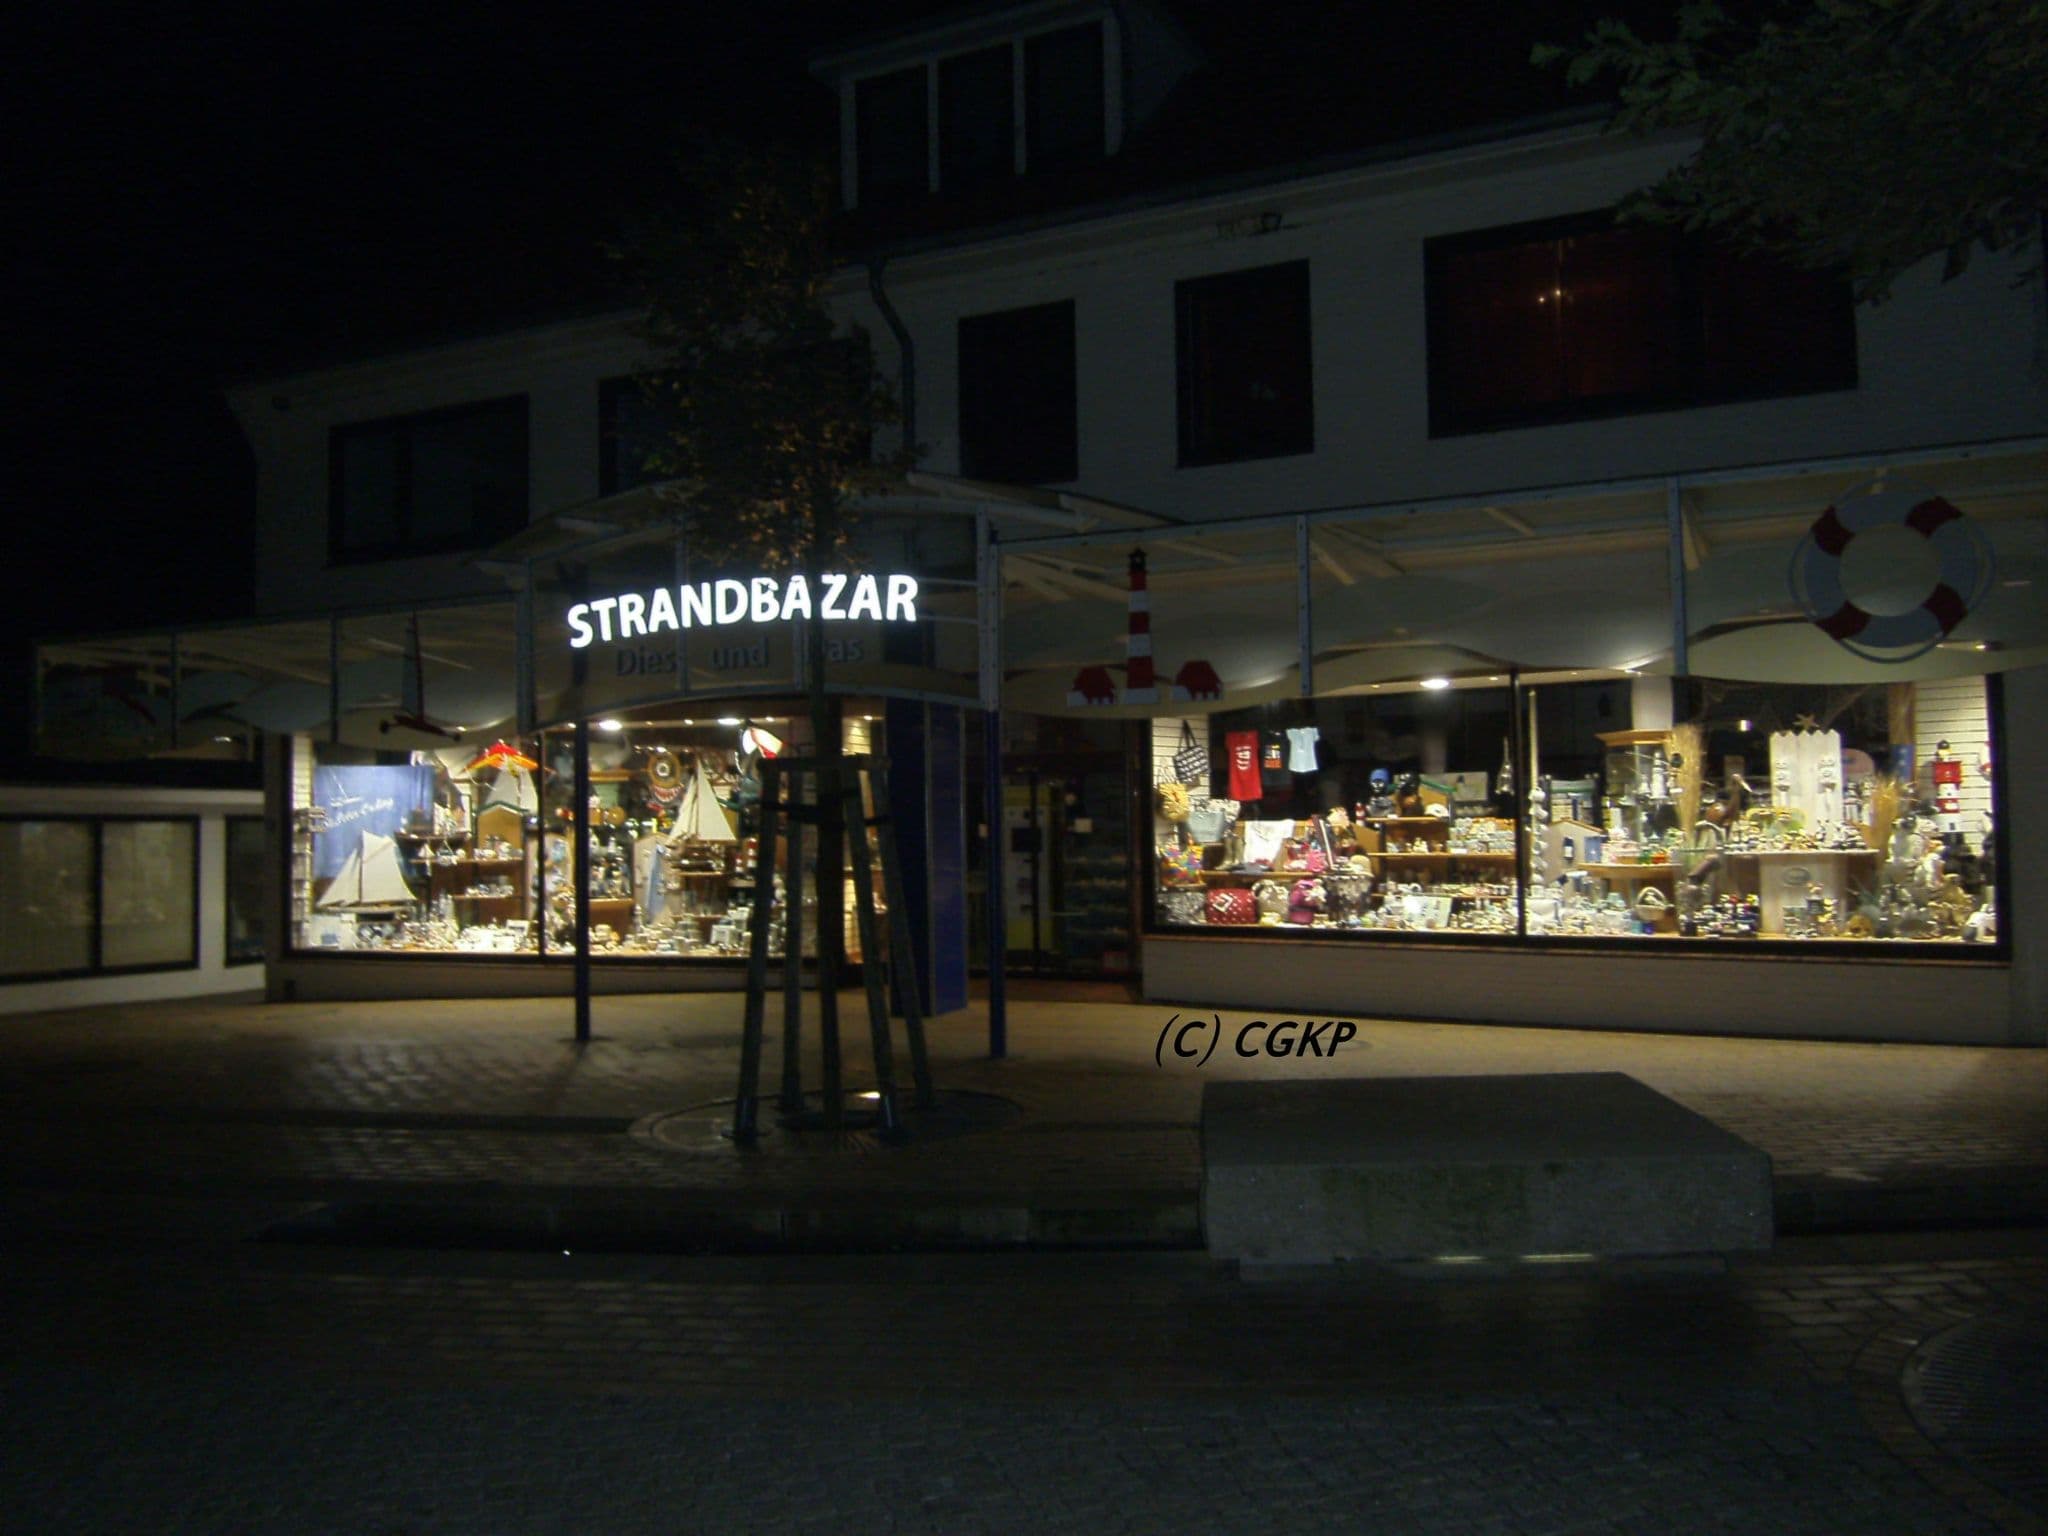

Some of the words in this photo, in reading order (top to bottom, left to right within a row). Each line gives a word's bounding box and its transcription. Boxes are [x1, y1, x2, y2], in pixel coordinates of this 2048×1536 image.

[566, 573, 920, 649] STRANDBAZAR
[616, 645, 677, 677] Dies
[711, 636, 769, 671] und
